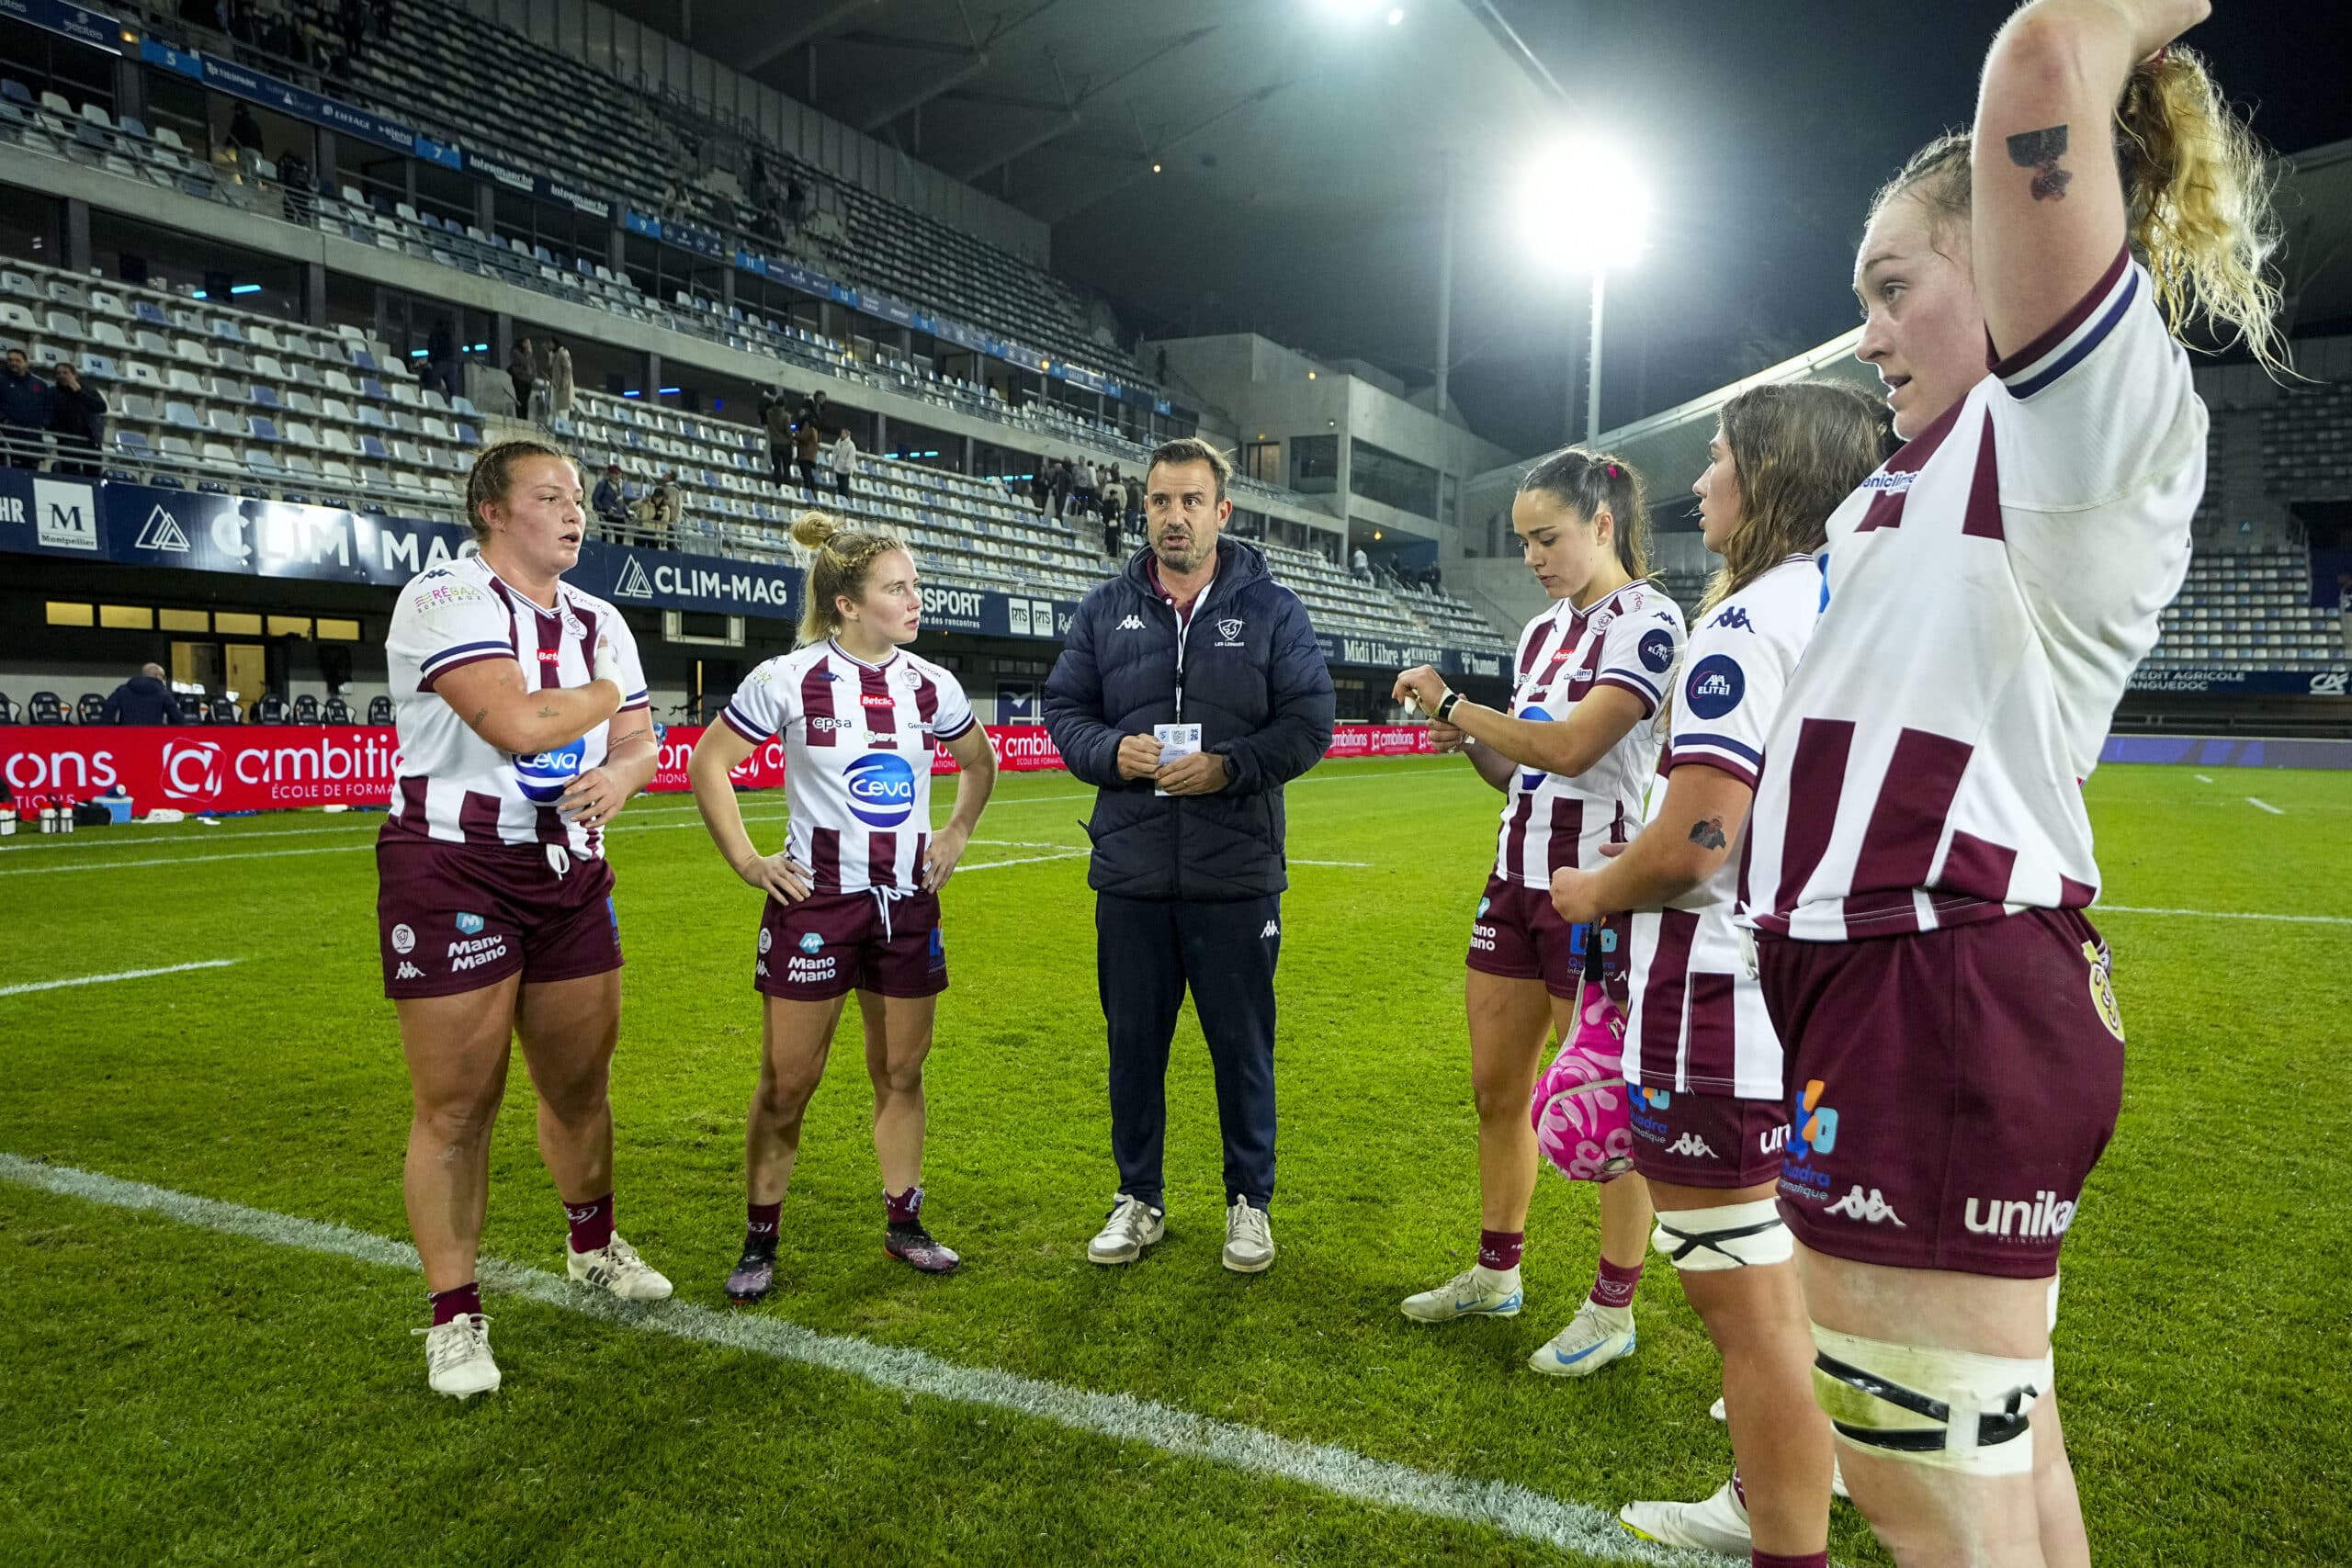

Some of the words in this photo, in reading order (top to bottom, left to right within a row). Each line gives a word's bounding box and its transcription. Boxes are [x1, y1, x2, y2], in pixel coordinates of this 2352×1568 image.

[41, 535, 95, 547] Montpellier
[654, 566, 787, 605] CLIM-MAG
[931, 616, 944, 626] des
[944, 618, 980, 629] rencontres
[1012, 607, 1028, 622] RTS
[1035, 609, 1051, 625] RTS
[1343, 639, 1370, 662] Midi
[1372, 643, 1398, 666] Libre
[2173, 671, 2245, 682] AGRICOLE
[2125, 681, 2209, 691] ANGUEDOC
[862, 695, 893, 705] Betclic
[814, 716, 853, 731] epsa
[271, 784, 319, 799] ÉCOLE
[323, 784, 341, 797] DE
[345, 783, 394, 796] FORMA
[1472, 922, 1497, 938] ano
[447, 934, 503, 957] Mano
[1469, 935, 1496, 951] ano
[452, 944, 506, 972] Mano
[787, 956, 836, 969] Mano
[787, 967, 836, 984] Mano
